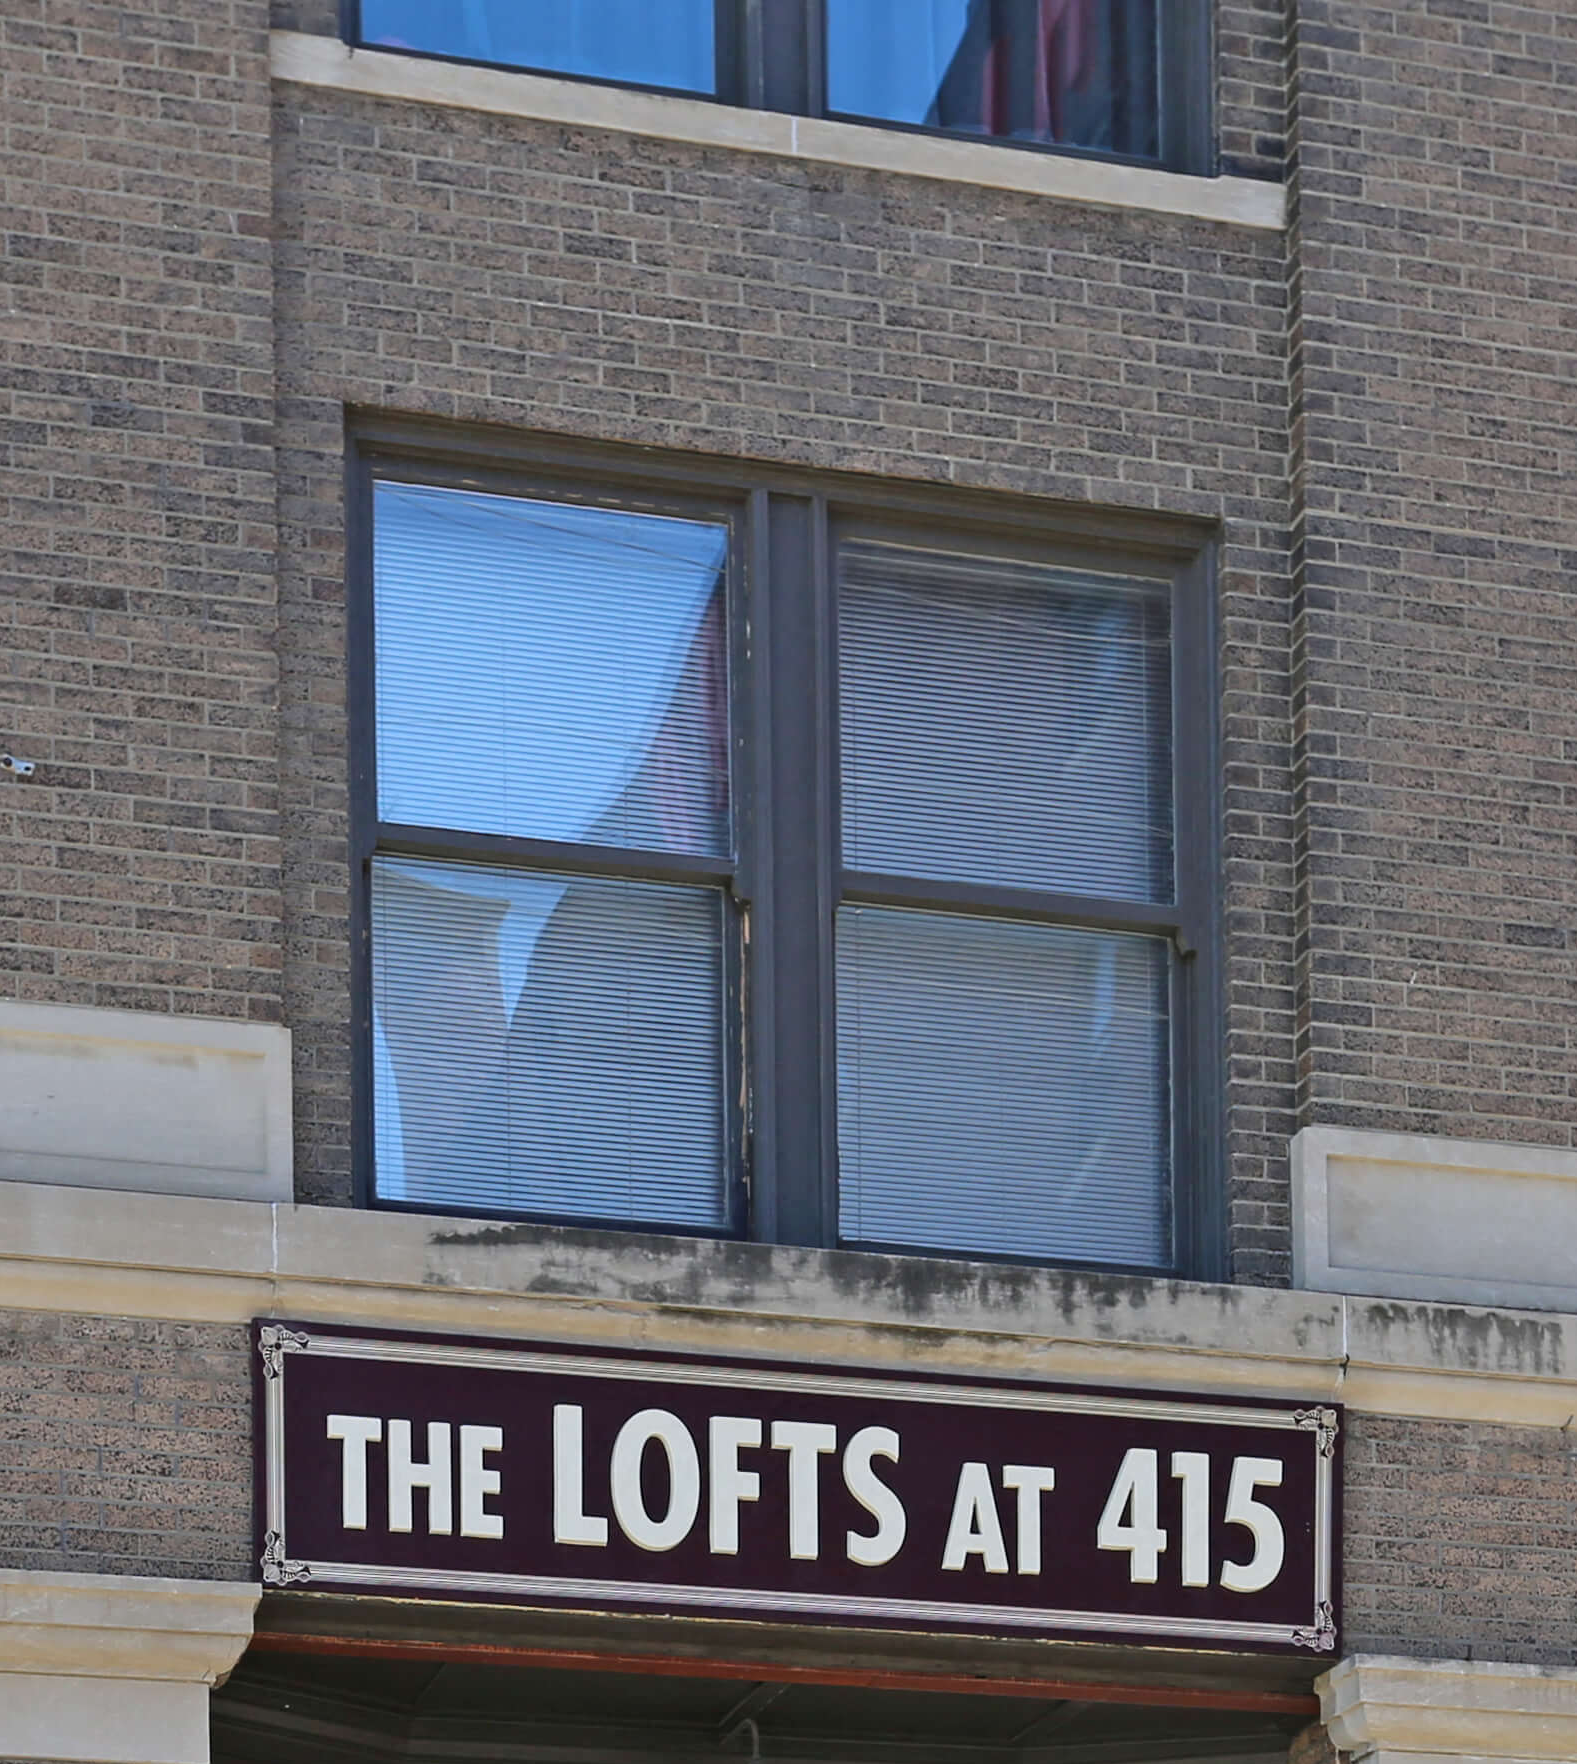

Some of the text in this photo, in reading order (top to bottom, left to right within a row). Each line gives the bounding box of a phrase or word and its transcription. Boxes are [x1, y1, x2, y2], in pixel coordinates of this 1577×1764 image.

[327, 1404, 1285, 1594] THE LOFTS AT 415
